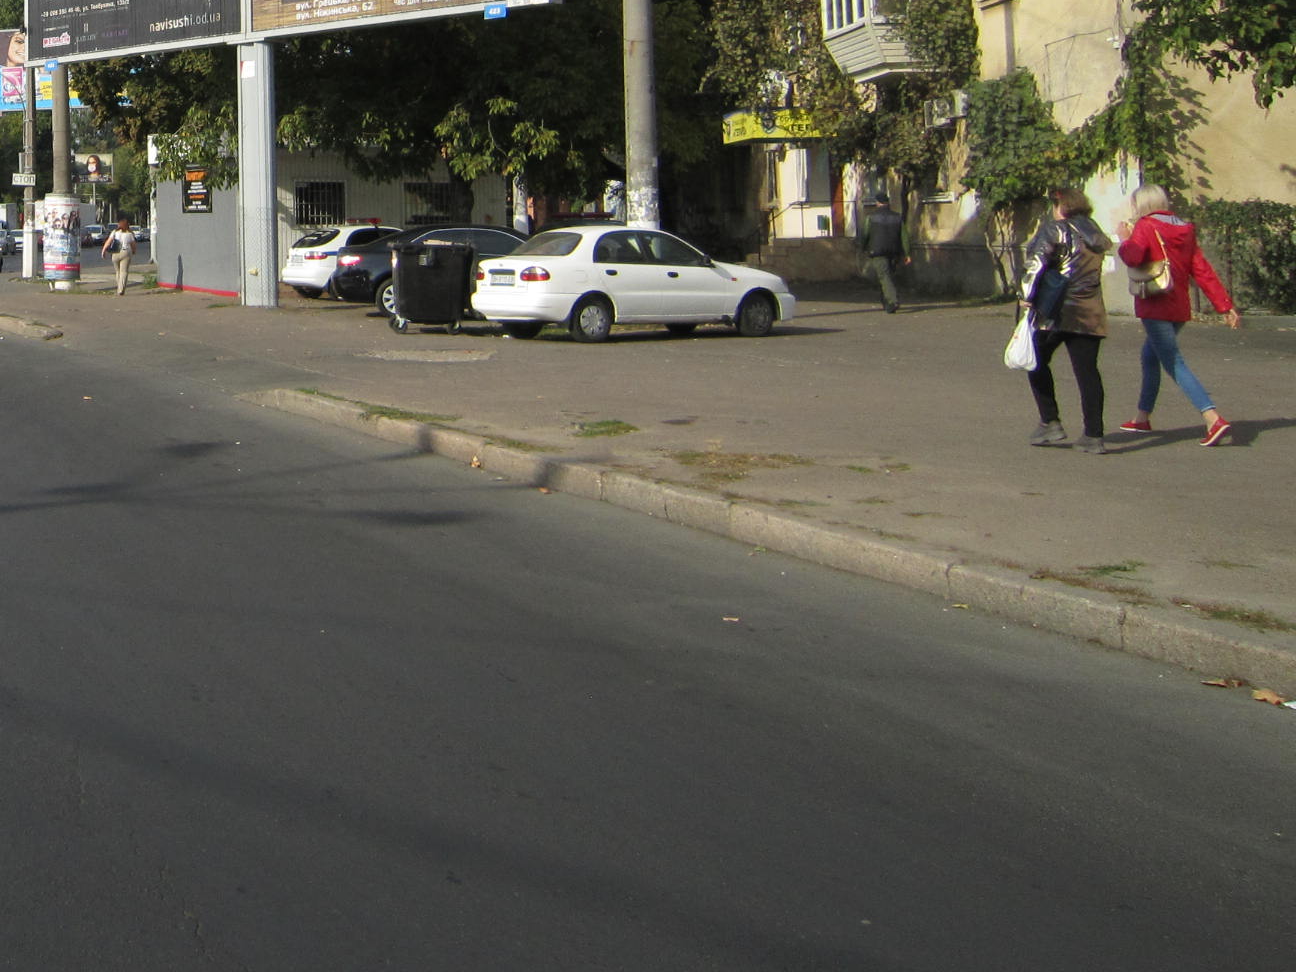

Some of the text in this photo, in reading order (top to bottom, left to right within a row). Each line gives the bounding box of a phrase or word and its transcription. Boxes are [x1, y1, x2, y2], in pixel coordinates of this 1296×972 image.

[295, 2, 312, 12] вул.
[295, 11, 312, 20] вул.
[149, 12, 221, 33] navisushi.od.ua
[13, 174, 35, 184] СТОП
